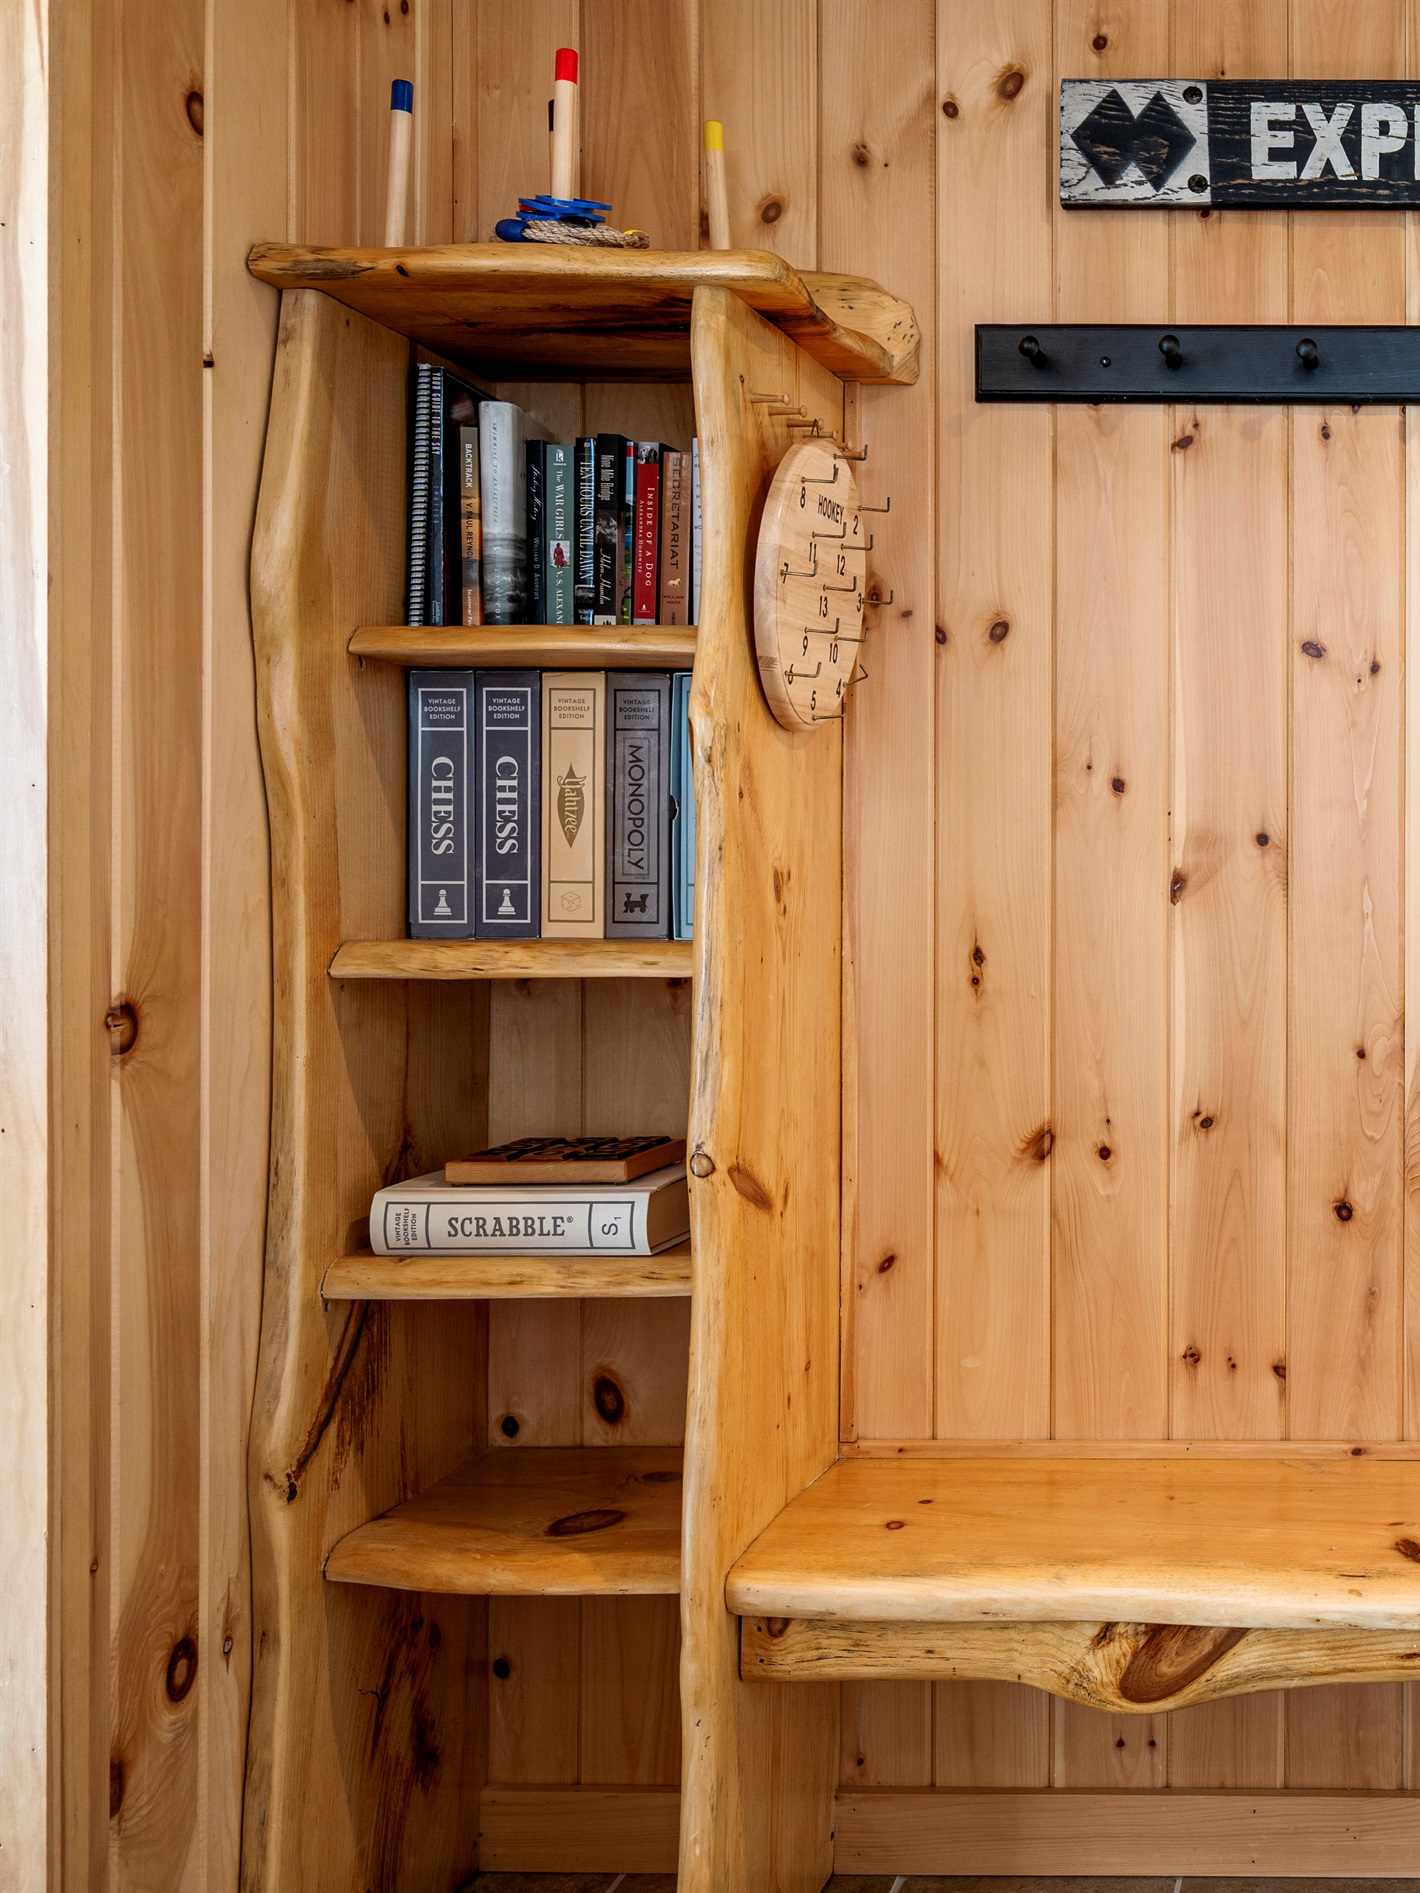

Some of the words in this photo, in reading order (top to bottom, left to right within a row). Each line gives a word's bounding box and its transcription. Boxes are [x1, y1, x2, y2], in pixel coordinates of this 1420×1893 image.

[431, 372, 441, 390] YOUR
[431, 393, 441, 412] GUIDE
[431, 427, 441, 439] THE
[431, 442, 441, 455] SKY
[465, 443, 473, 488] BACKTRACK
[493, 464, 498, 474] TO
[580, 462, 594, 479] TEN
[601, 455, 614, 468] Nine
[601, 469, 614, 482] Mile
[555, 484, 565, 505] WAR
[580, 482, 594, 516] HOURS
[597, 482, 614, 501] Bridge
[800, 486, 806, 508] 8
[646, 487, 655, 525] INSIDE
[671, 457, 681, 570] SECRETARIAT
[818, 494, 845, 525] HOOKEY
[555, 509, 565, 539] GIRLS
[580, 518, 594, 548] UNTIL
[853, 515, 859, 535] 2
[646, 531, 653, 545] OF
[466, 531, 474, 570] REYNOLDS
[600, 548, 611, 573] Helen
[808, 542, 817, 564] 11
[556, 570, 563, 578] V.
[580, 551, 594, 579] DAWN
[645, 563, 654, 587] DOG
[782, 562, 789, 584] 7
[836, 554, 846, 577] 12
[556, 579, 563, 587] S.
[600, 574, 611, 605] Hamlin
[819, 595, 828, 618] 13
[856, 592, 862, 612] 3
[802, 635, 809, 656] 9
[829, 642, 838, 664] 10
[787, 664, 794, 685] 6
[835, 678, 842, 698] 4
[810, 690, 816, 711] 5
[431, 756, 455, 855] CHESS
[495, 756, 519, 854] CHESS
[556, 775, 587, 833] Yahtzee
[628, 744, 645, 871] MONOPOLY
[402, 1207, 411, 1246] BOOKSHELF
